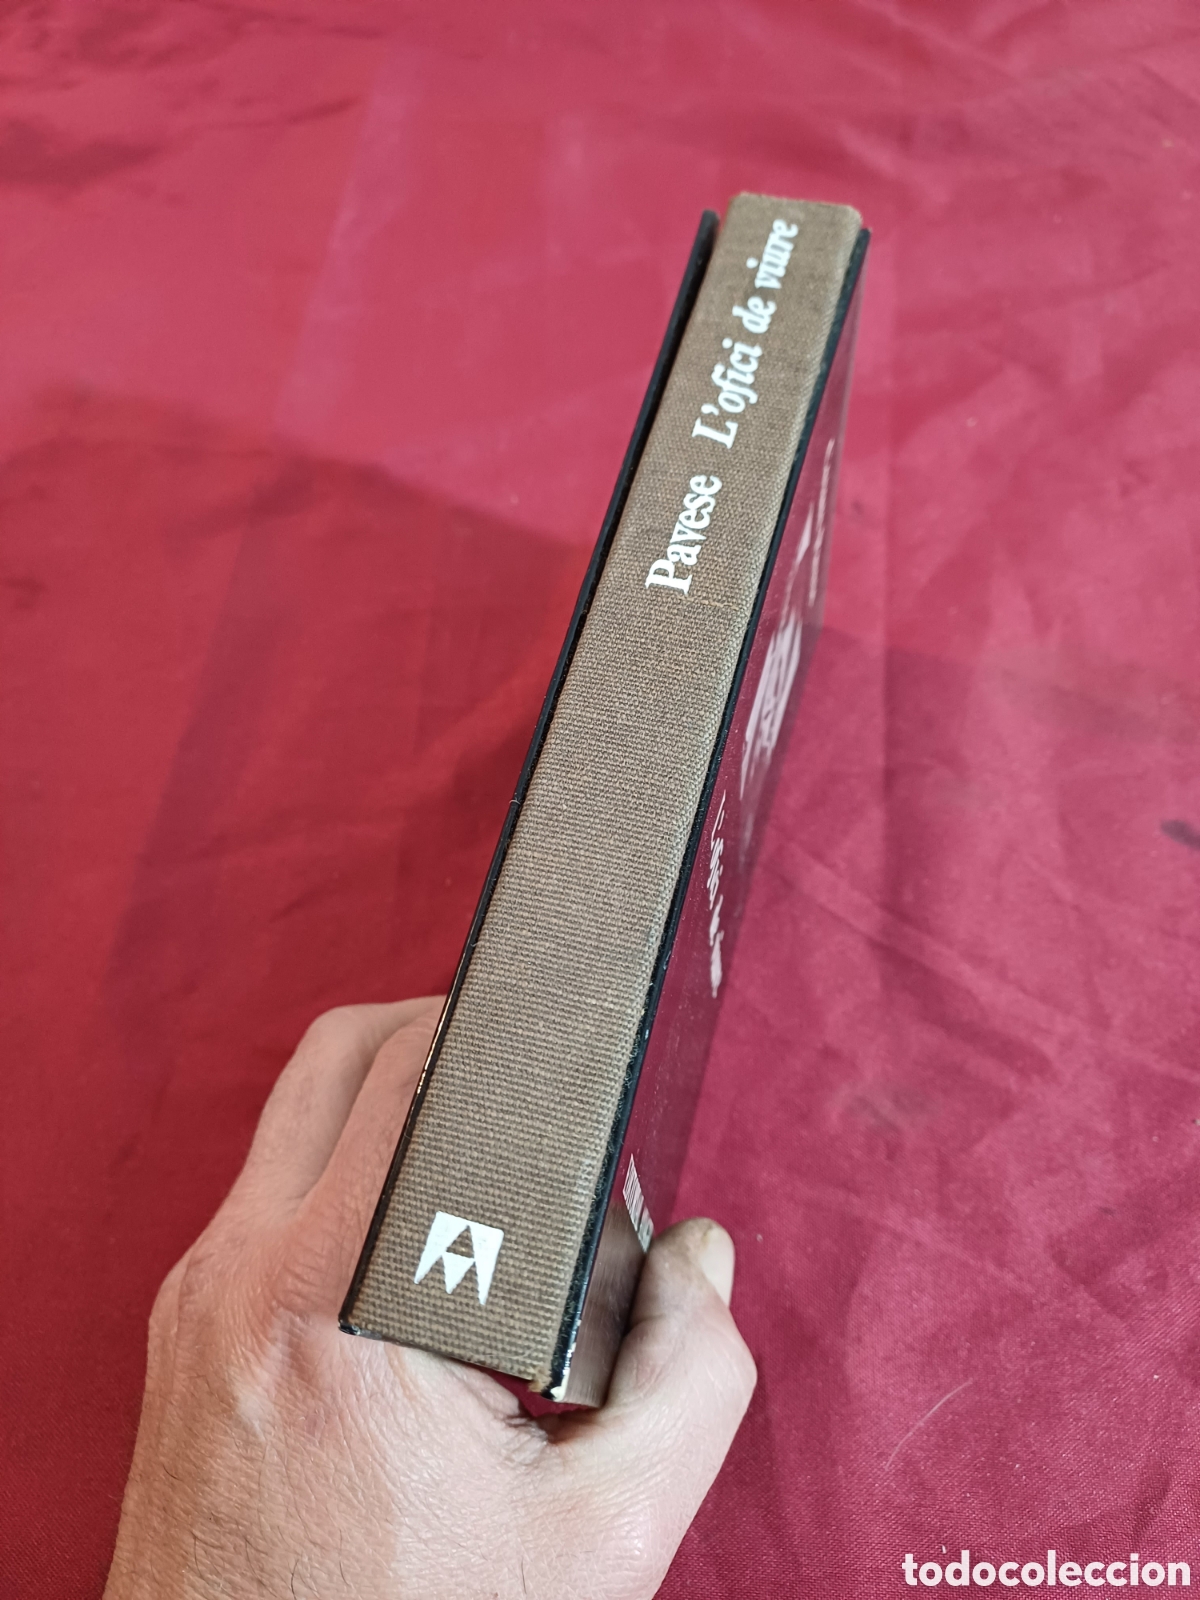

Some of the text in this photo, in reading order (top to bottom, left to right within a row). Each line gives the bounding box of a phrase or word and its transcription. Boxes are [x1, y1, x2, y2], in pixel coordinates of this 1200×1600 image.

[645, 218, 799, 595] Pavese L'ofici de viure
